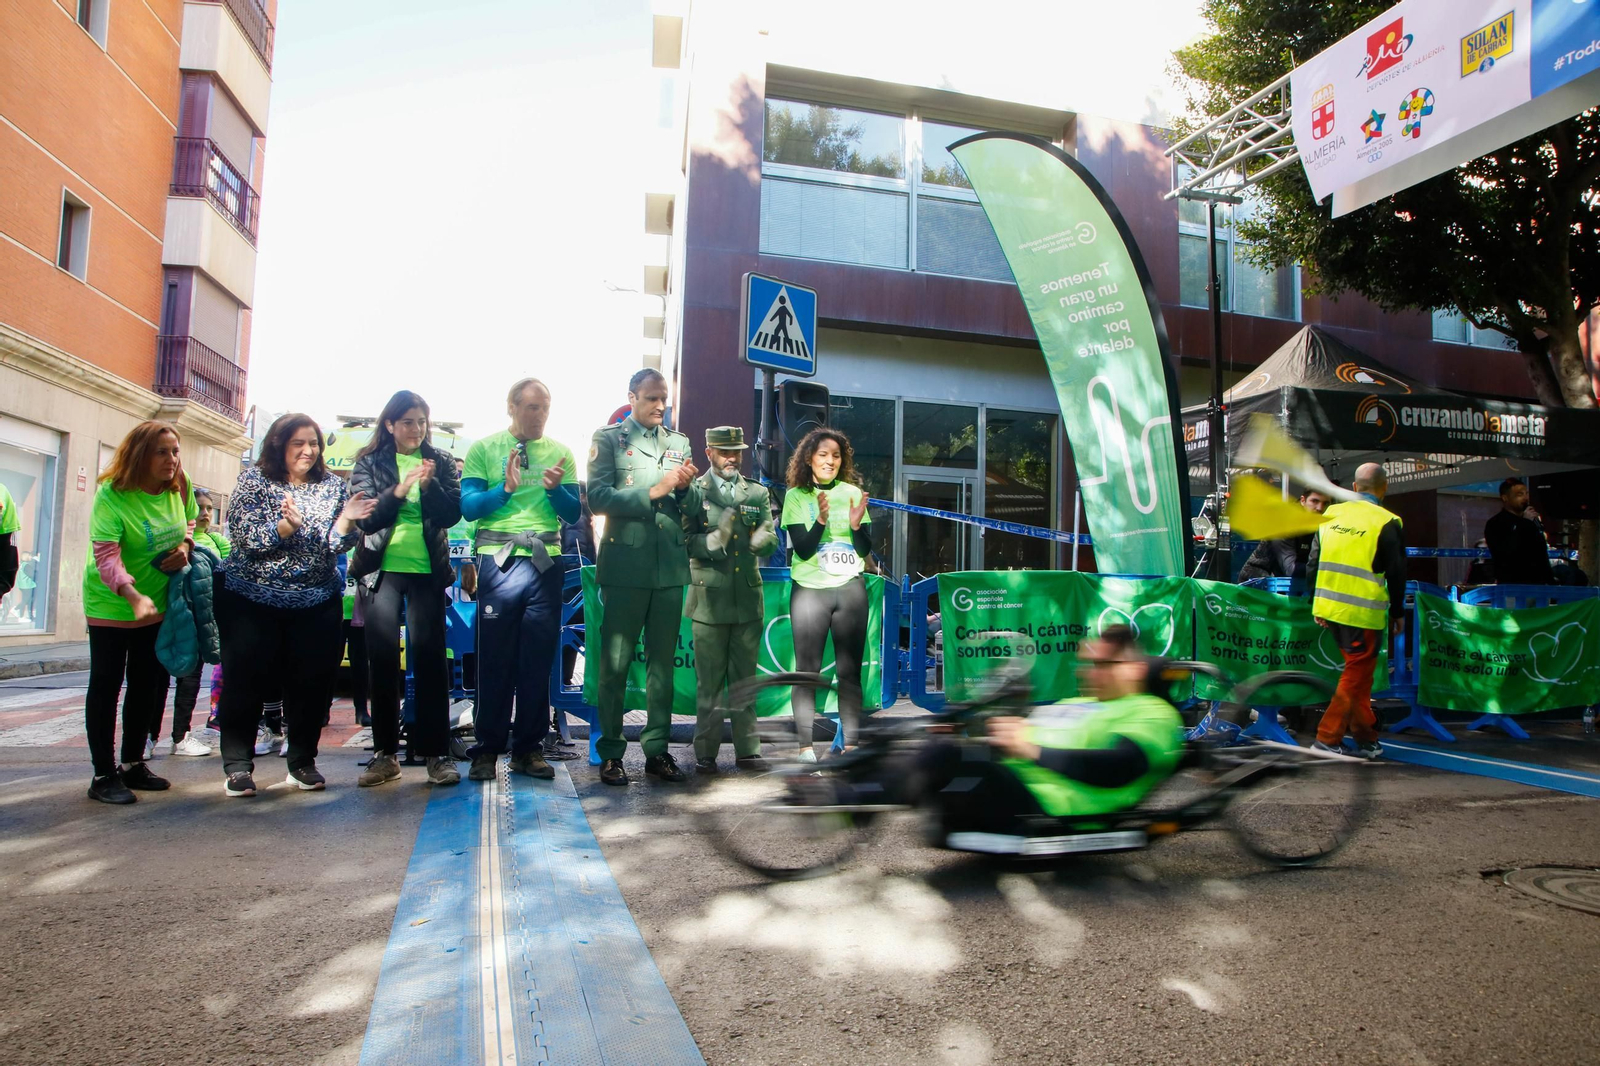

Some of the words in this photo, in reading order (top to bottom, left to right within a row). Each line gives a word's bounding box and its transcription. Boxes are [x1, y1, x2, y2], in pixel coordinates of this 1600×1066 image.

[1467, 52, 1476, 65] DE
[1478, 36, 1507, 59] CABRAS
[1378, 137, 1394, 150] 2005
[1304, 135, 1346, 167] ALMERÍA
[821, 552, 855, 565] 1600
[955, 625, 1013, 640] Contra
[1017, 623, 1034, 638] el
[1037, 622, 1091, 638] cáncer
[957, 645, 1012, 658] somos
[1016, 640, 1052, 656] solo
[1056, 641, 1080, 653] un
[1256, 636, 1269, 648] el
[1270, 637, 1313, 650] cáncer
[1252, 651, 1281, 666] solo
[1283, 654, 1307, 665] uno
[1470, 649, 1483, 661] el
[1463, 663, 1493, 676] solo
